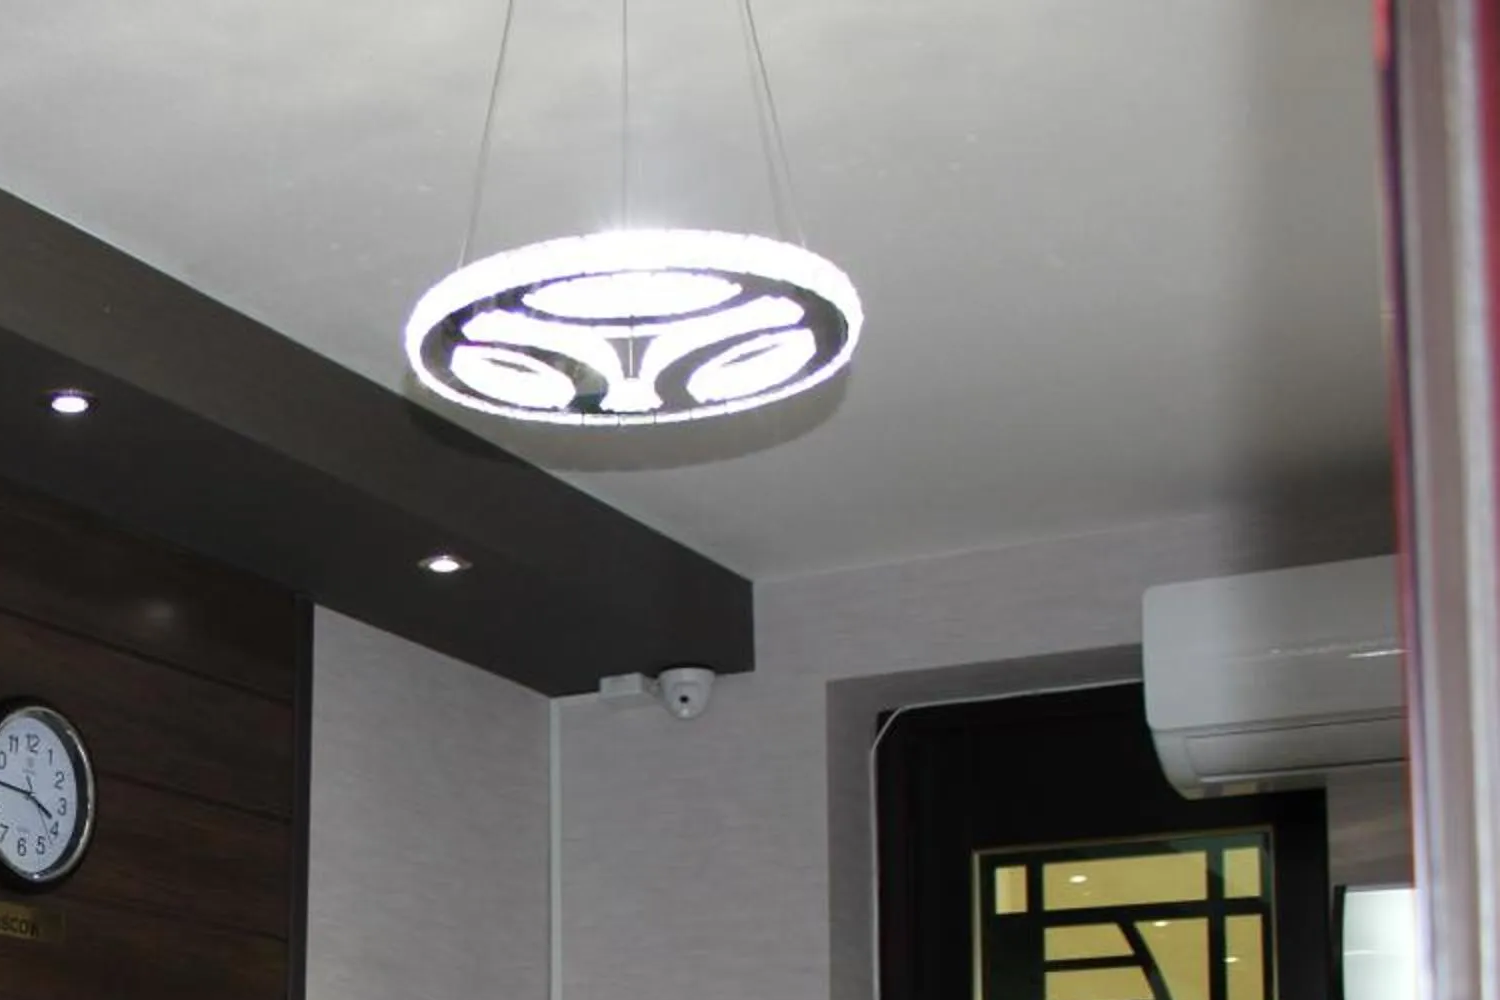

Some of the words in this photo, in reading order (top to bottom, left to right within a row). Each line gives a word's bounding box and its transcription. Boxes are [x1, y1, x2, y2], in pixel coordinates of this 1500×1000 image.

[8, 734, 19, 752] 11
[26, 733, 40, 753] 12
[54, 771, 65, 790] 2
[57, 797, 67, 816] 3
[0, 823, 9, 843] 7
[50, 821, 59, 838] 4
[16, 837, 27, 857] 6
[35, 835, 46, 854] 5
